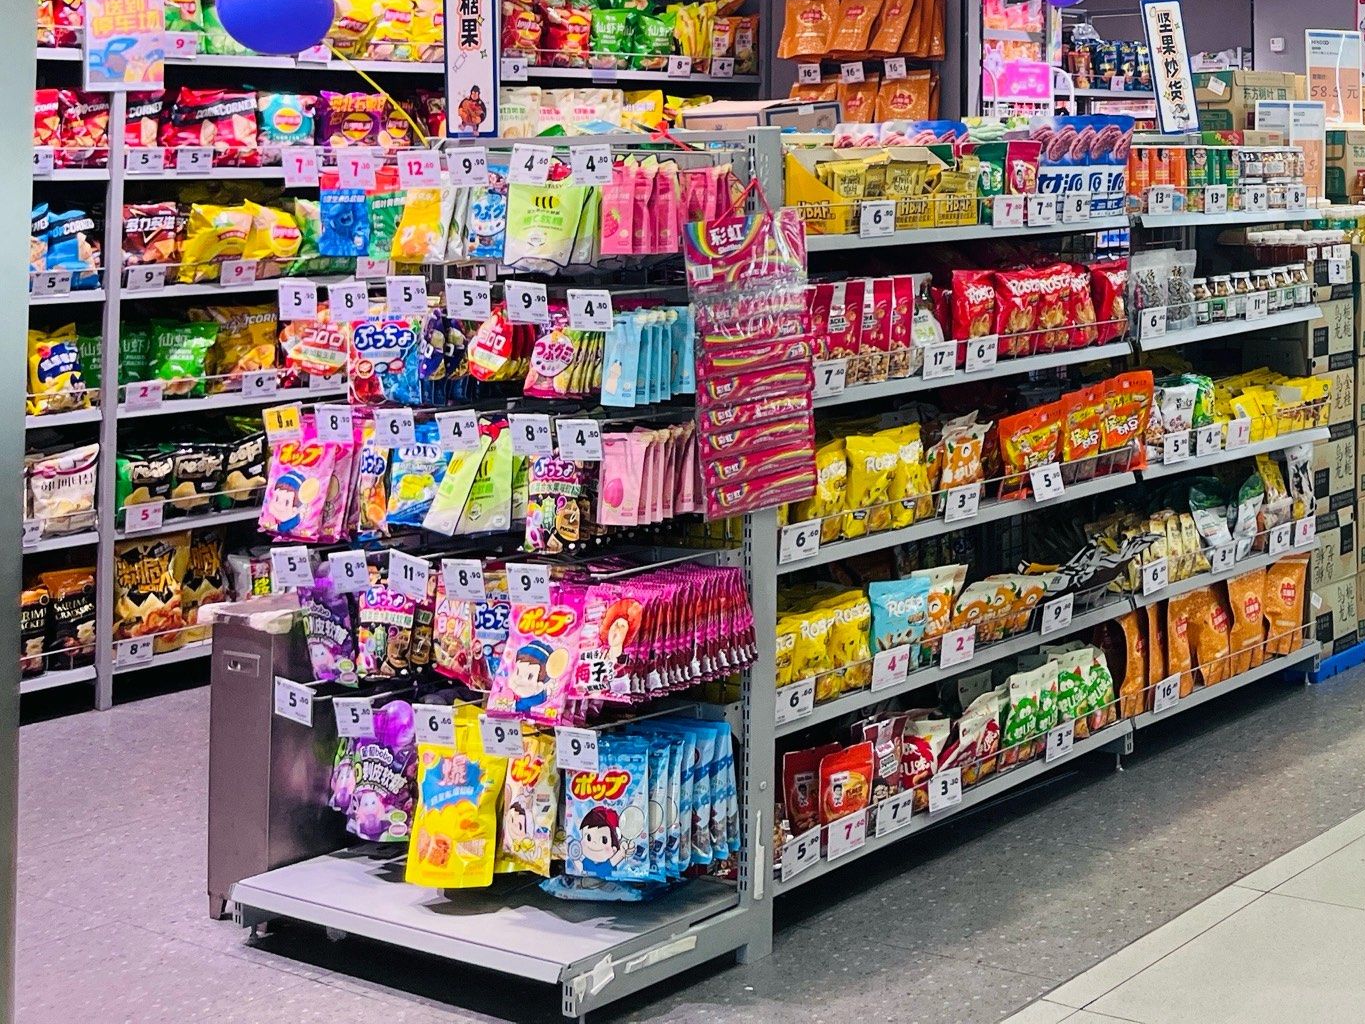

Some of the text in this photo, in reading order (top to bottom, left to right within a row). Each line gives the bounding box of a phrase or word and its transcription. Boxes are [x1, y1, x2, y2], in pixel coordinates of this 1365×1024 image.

[1157, 11, 1183, 101] 坚果炒货
[1347, 85, 1359, 99] 元
[710, 224, 745, 247] 彩虹
[355, 327, 415, 350] ぷっちょ
[519, 607, 575, 635] ポップ
[573, 772, 629, 800] ポップ
